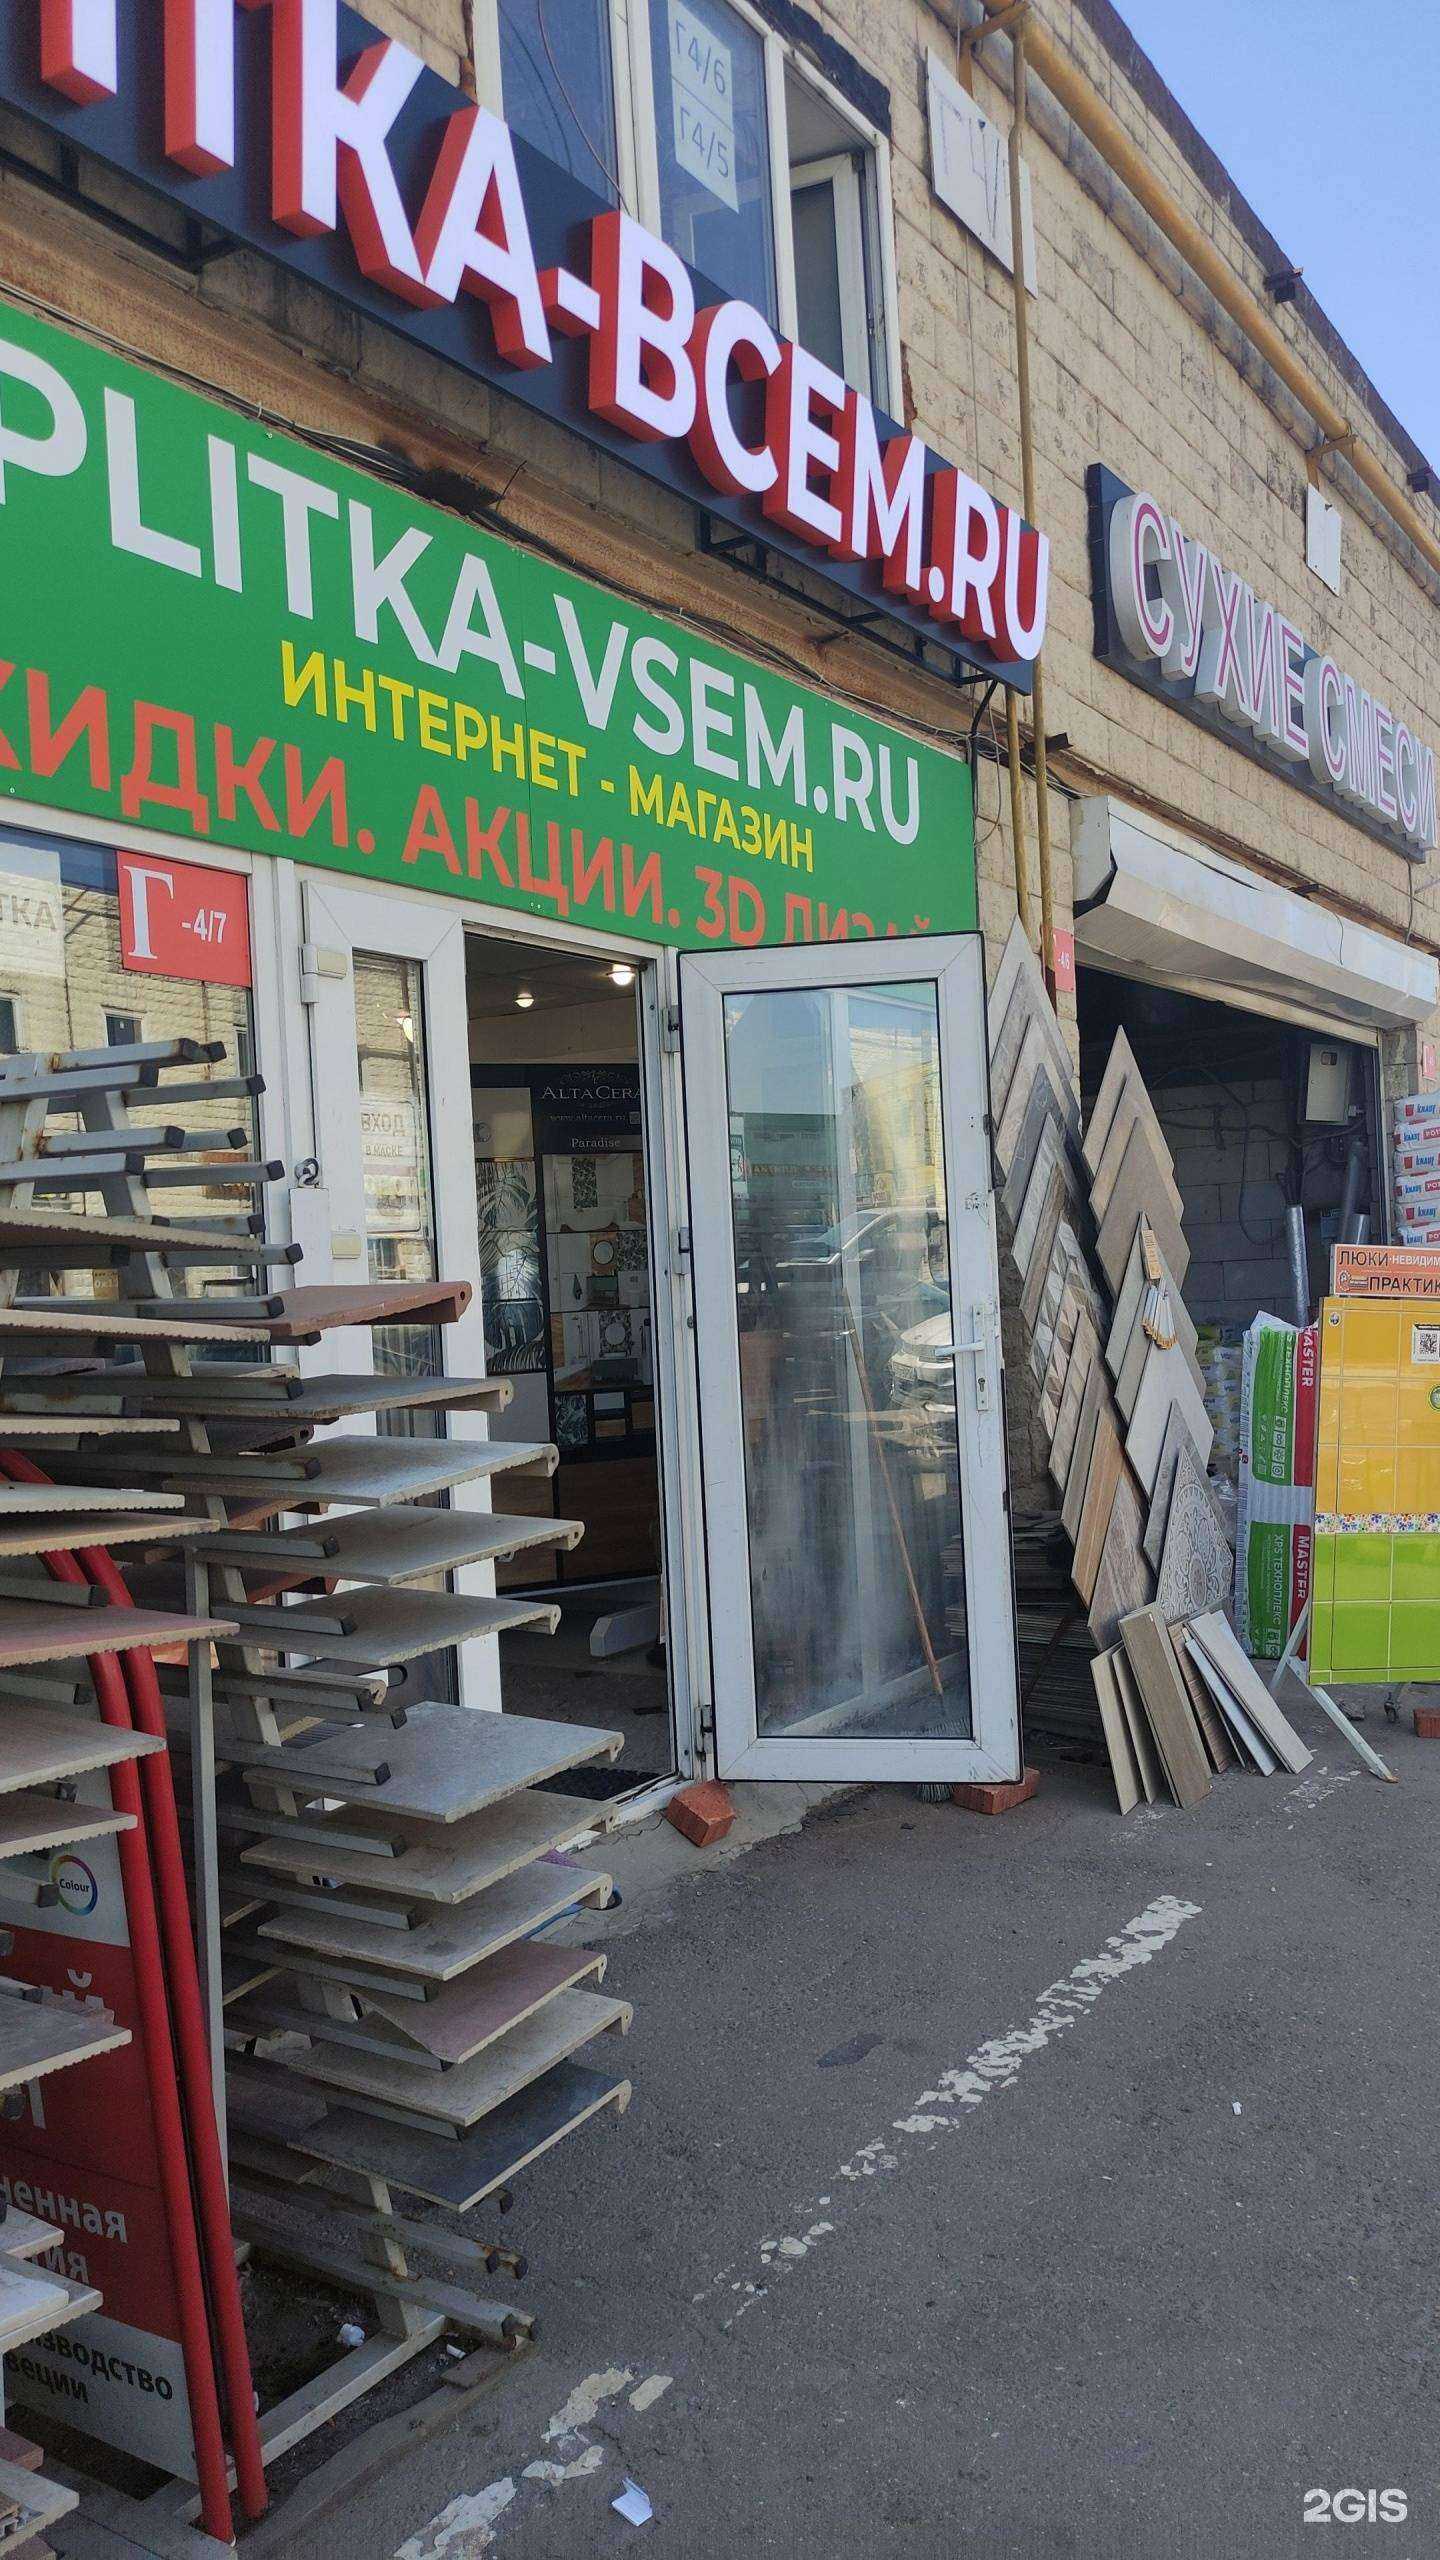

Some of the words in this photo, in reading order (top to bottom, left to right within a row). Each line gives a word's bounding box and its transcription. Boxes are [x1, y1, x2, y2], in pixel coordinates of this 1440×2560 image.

[1112, 492, 1310, 762] СУХИЕ
[1304, 655, 1438, 850] СМЕСИ
[281, 640, 587, 797] ИНТЕРНЕТ
[628, 765, 814, 874] МАГАЗИН
[402, 784, 681, 929] АКЦИИ.
[695, 865, 766, 946] 3D
[123, 866, 174, 960] Г
[570, 1138, 621, 1149] Paradise
[1297, 1535, 1310, 1599] MASTER
[59, 1878, 90, 1893] Colour
[30, 2331, 173, 2401] зводство
